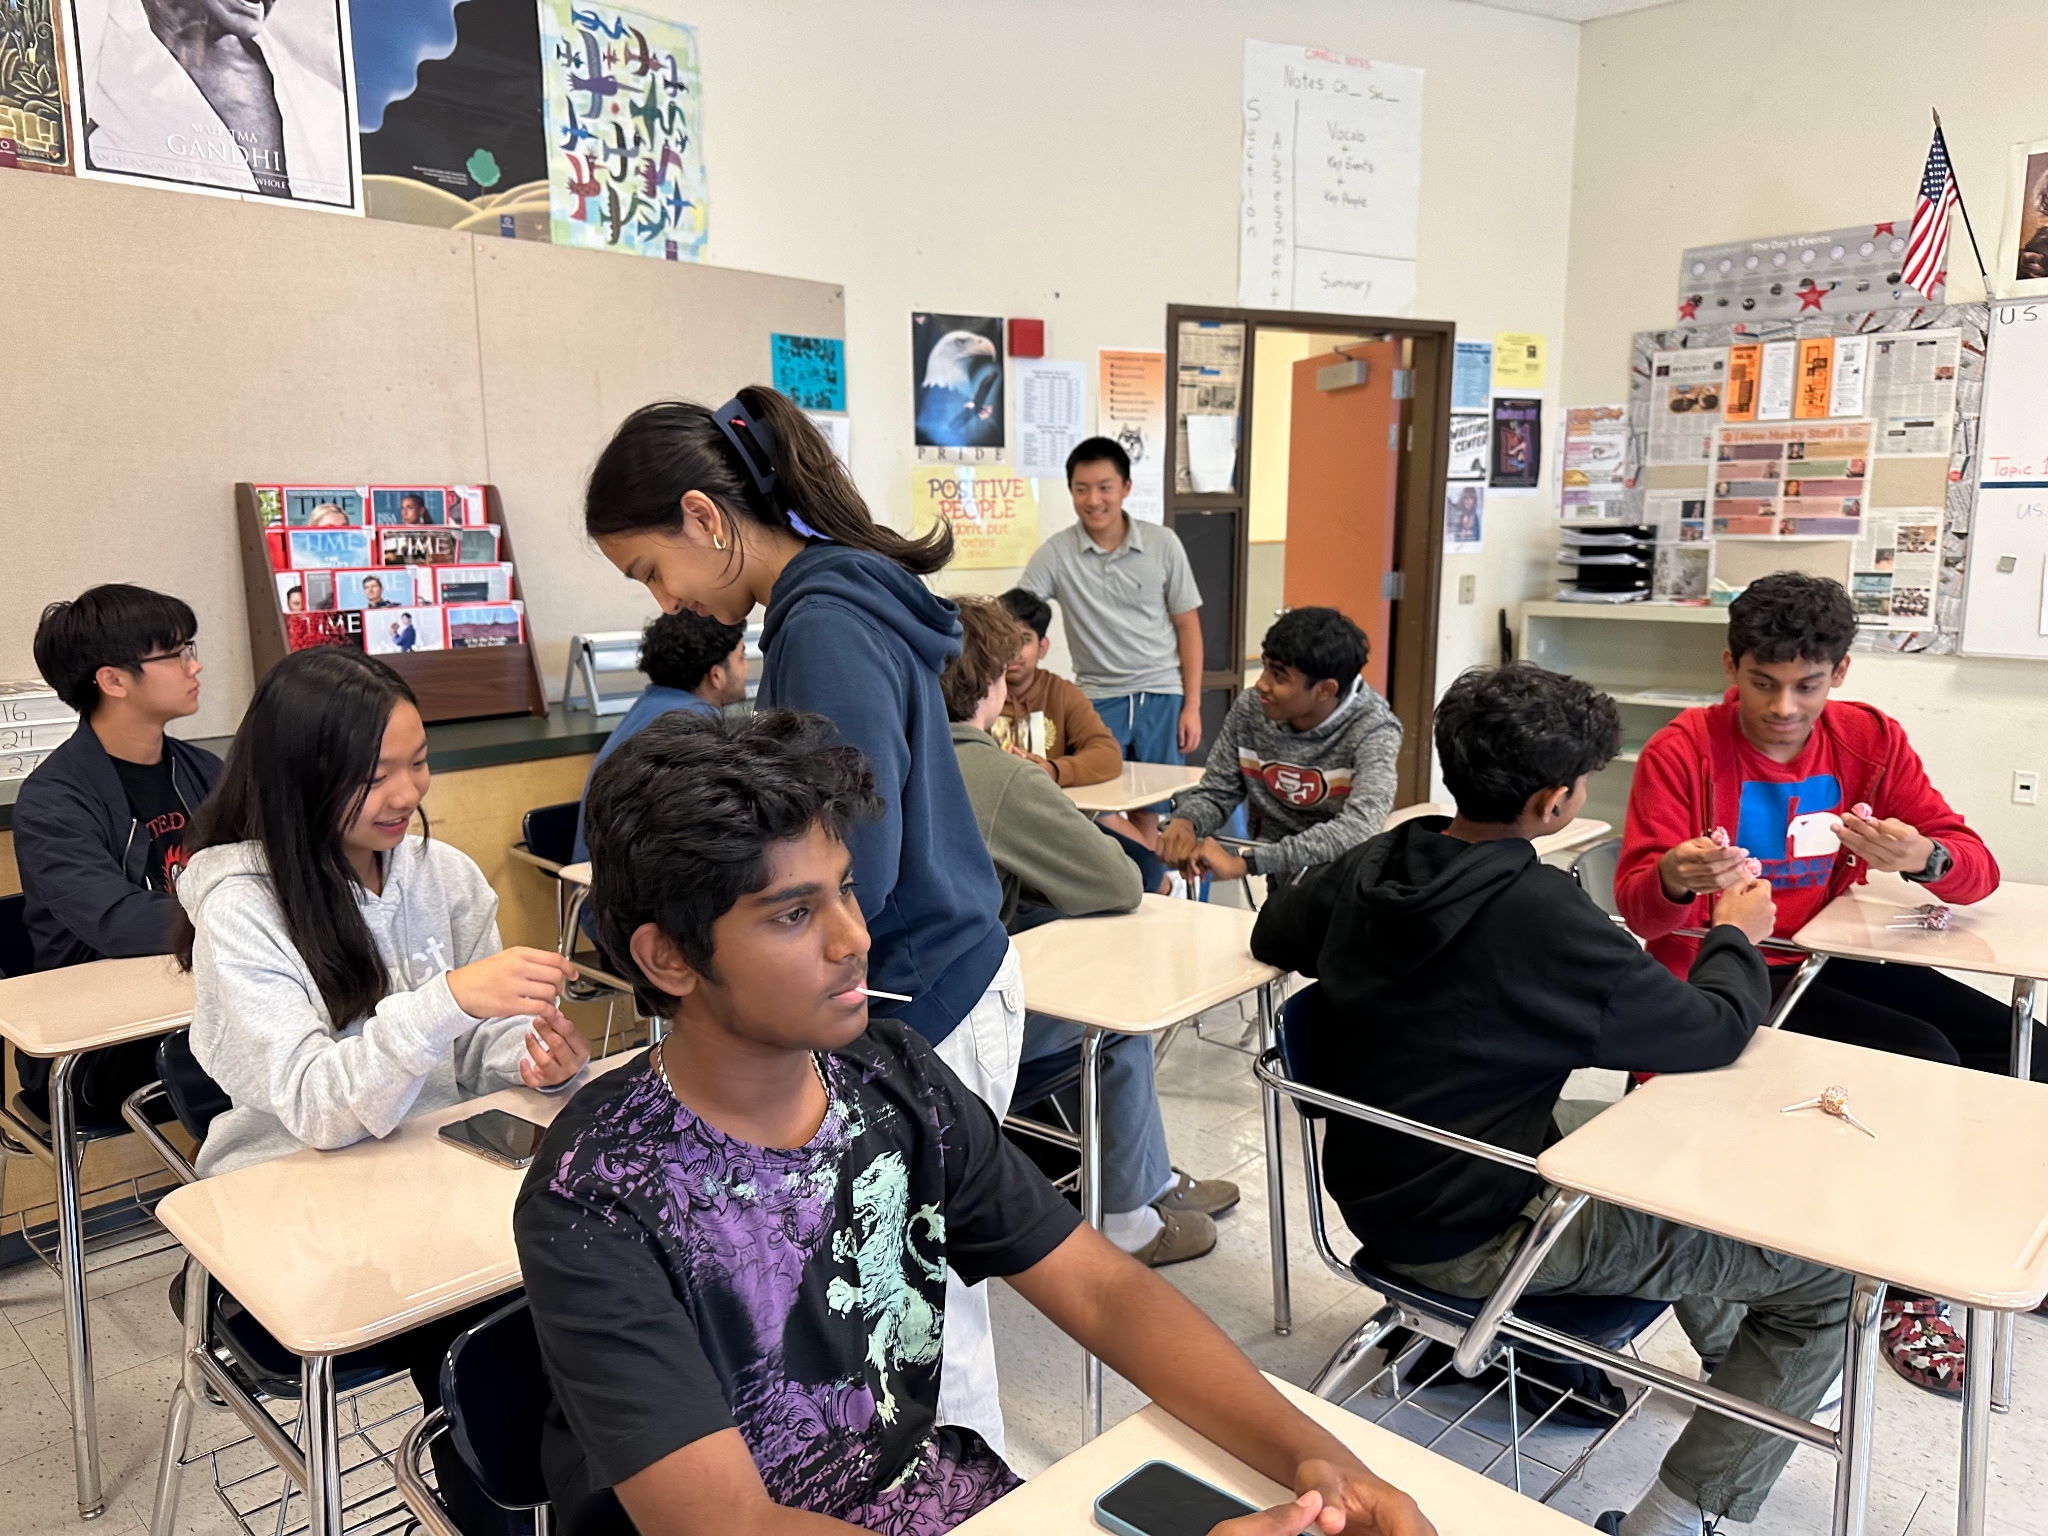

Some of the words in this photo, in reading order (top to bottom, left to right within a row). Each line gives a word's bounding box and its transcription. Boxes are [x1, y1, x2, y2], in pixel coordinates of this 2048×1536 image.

[1283, 65, 1325, 91] Notes
[1326, 119, 1366, 142] Vocab
[167, 133, 281, 172] GANDHI
[255, 177, 287, 190] WHOLE
[1319, 271, 1373, 300] Summary
[1454, 434, 1489, 453] CENTER
[917, 448, 1004, 461] PRIDE
[1989, 456, 2033, 478] Topic
[928, 478, 1025, 500] POSITIVE
[938, 500, 1017, 520] PEOPLE
[304, 533, 361, 552] TIME
[395, 536, 451, 556] TIME
[3, 703, 27, 722] 16
[1, 730, 33, 750] 24
[7, 754, 40, 773] 27
[145, 811, 187, 840] TED
